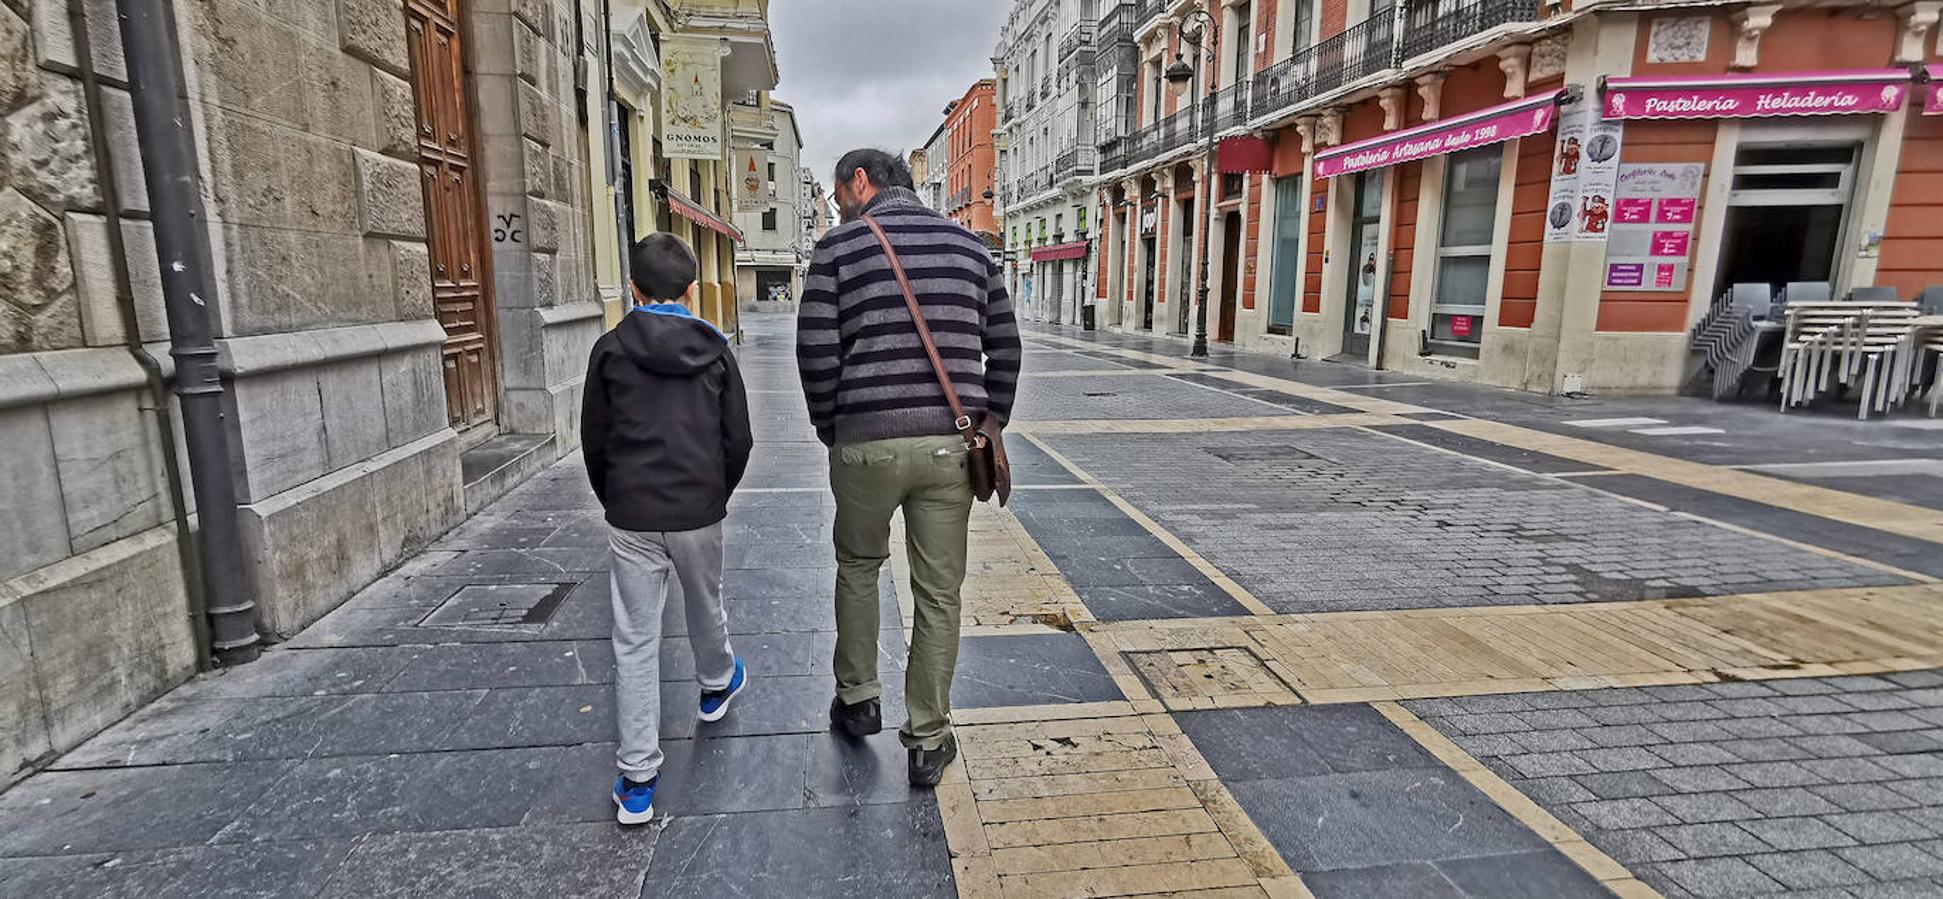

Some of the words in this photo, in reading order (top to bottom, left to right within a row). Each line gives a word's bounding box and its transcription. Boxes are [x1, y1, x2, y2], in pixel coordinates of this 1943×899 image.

[1645, 95, 1740, 113] Pastelería
[1756, 91, 1859, 111] Heladería
[666, 133, 717, 144] GNOMOS
[1343, 149, 1390, 170] Pastelería
[1392, 137, 1443, 159] Artesana
[1444, 130, 1472, 148] desde
[1473, 124, 1498, 141] 1998
